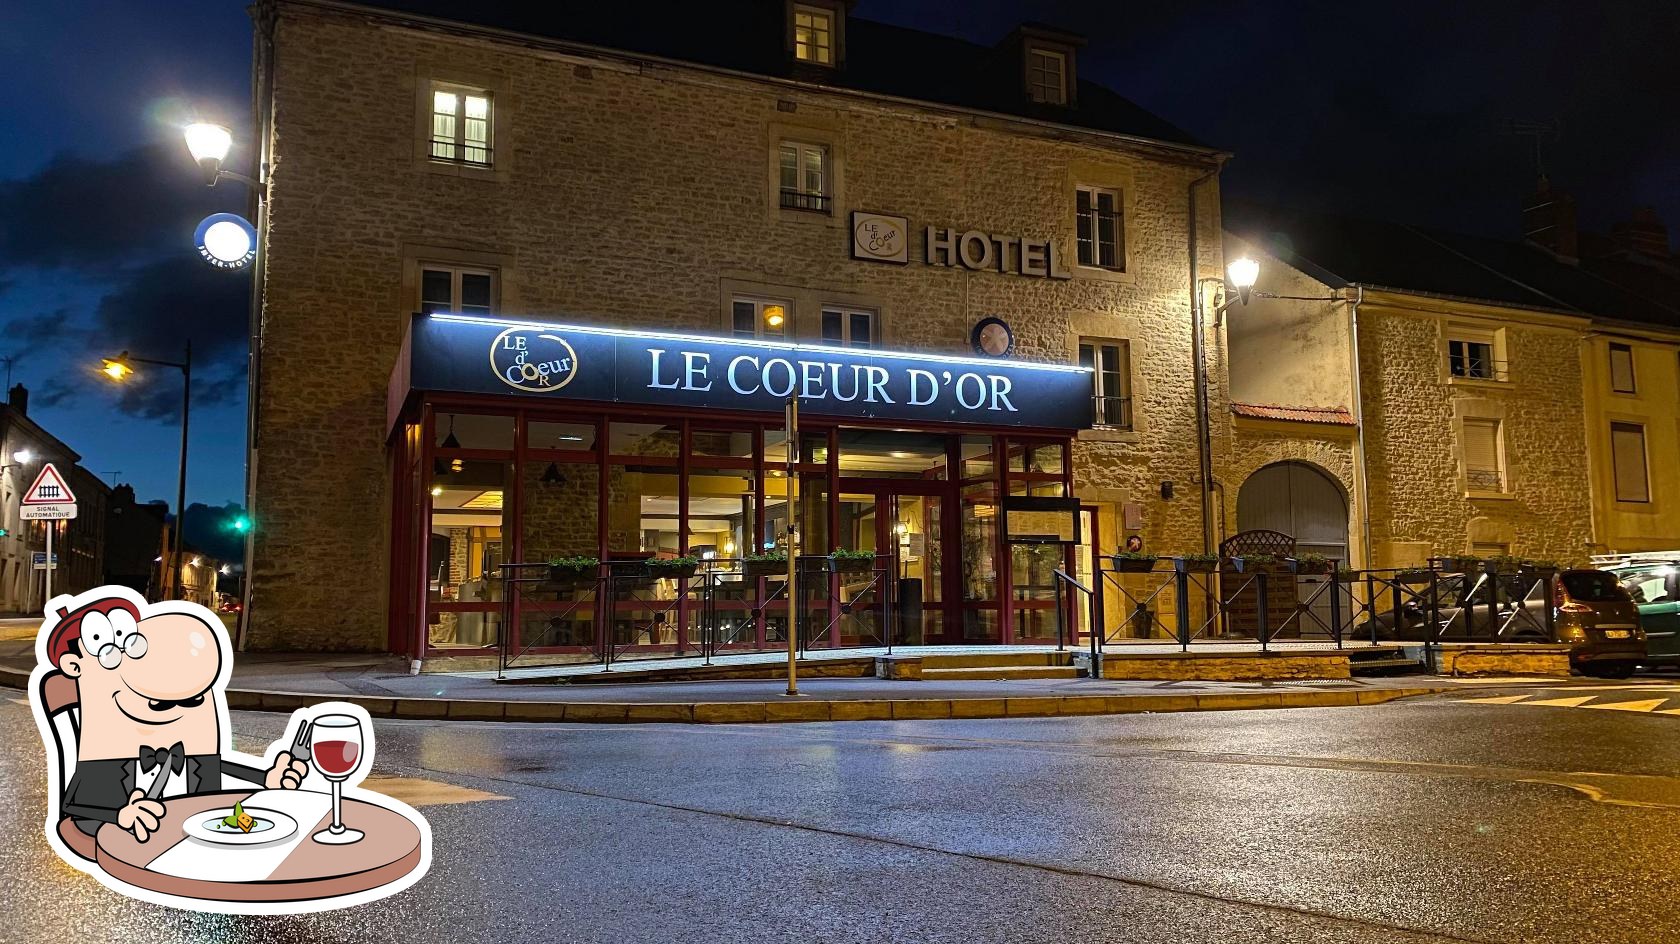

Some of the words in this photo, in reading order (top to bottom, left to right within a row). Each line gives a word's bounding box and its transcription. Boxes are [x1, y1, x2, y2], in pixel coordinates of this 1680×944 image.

[864, 223, 879, 232] LE
[198, 246, 256, 268] INTER-HOTEL
[927, 225, 1072, 279] HOTEL
[503, 336, 527, 351] LE
[647, 349, 713, 392] LE
[727, 355, 896, 404] COEUR
[906, 369, 1018, 412] D’OR
